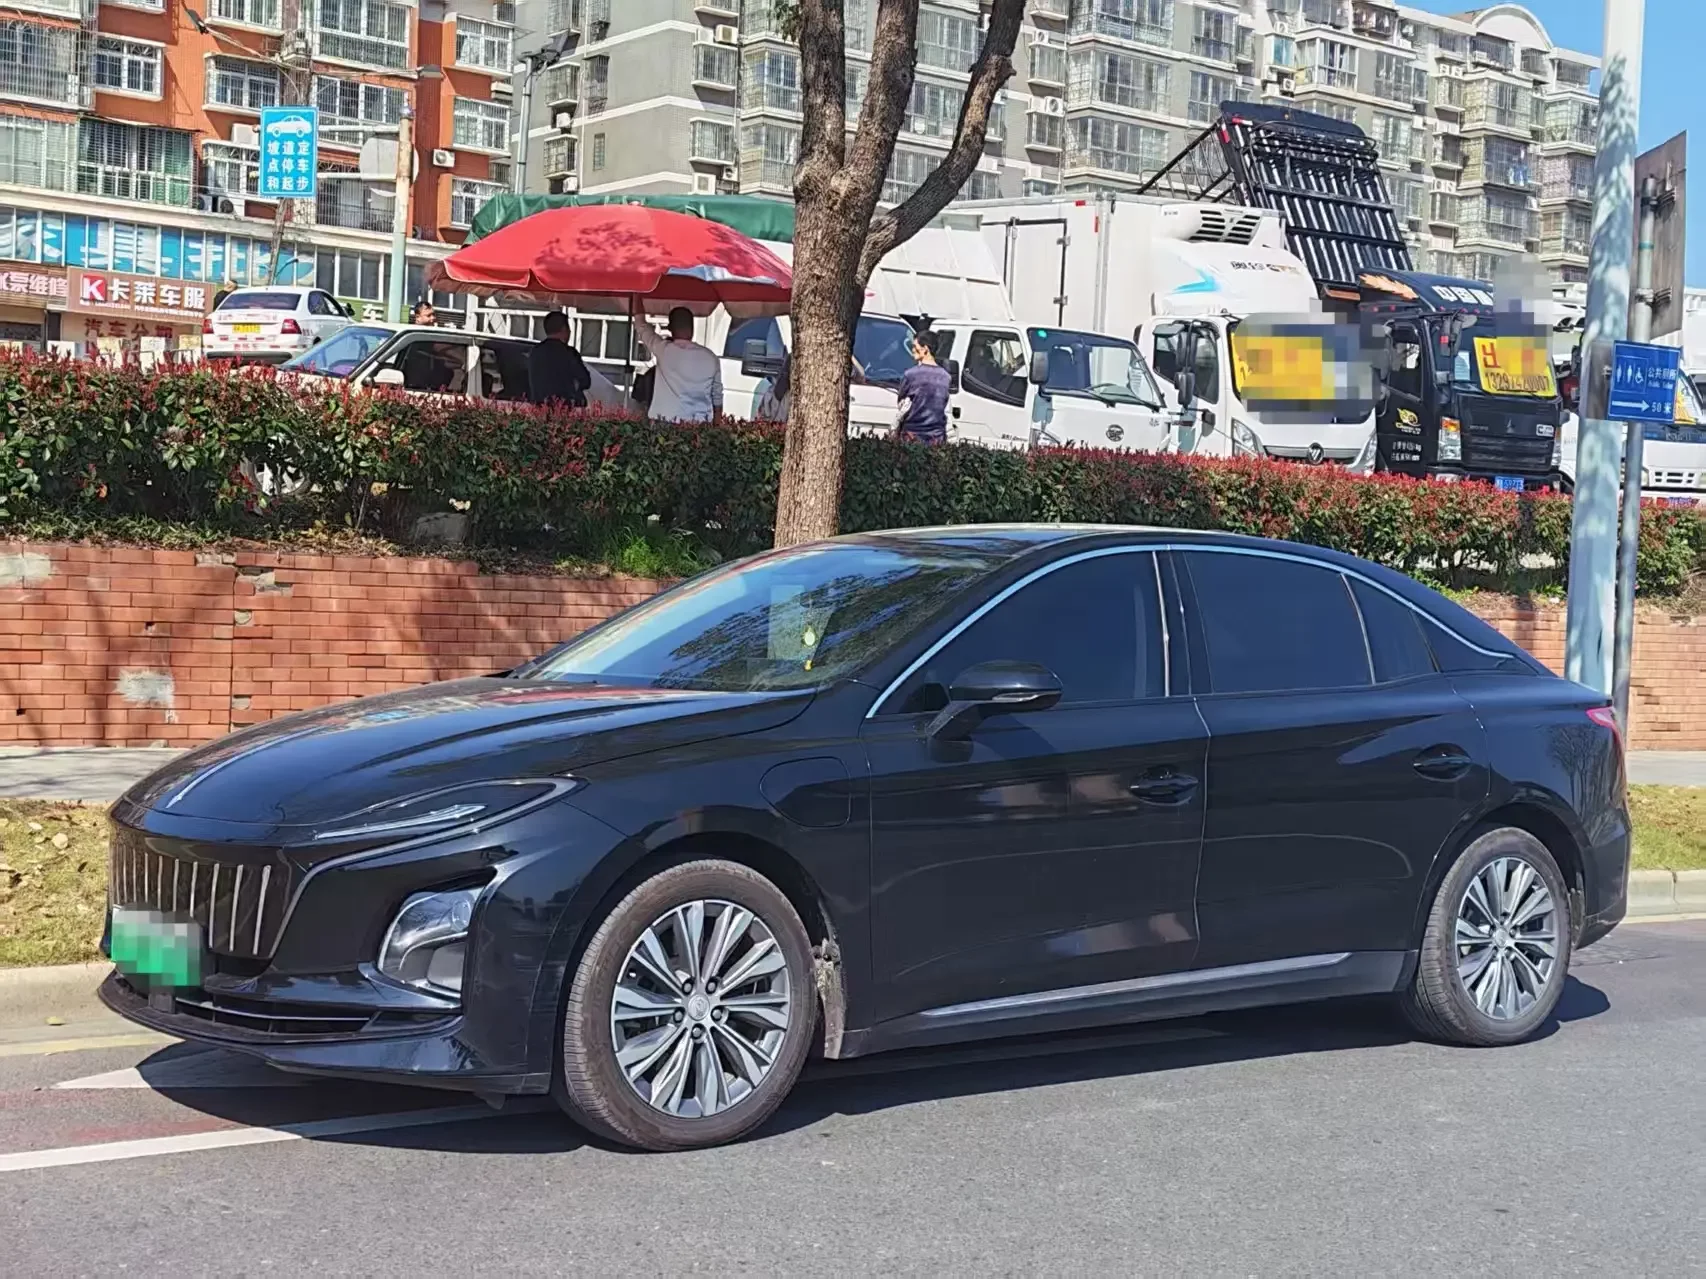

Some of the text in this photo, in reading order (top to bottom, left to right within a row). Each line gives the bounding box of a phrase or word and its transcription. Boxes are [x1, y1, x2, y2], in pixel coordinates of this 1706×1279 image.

[267, 157, 310, 174] 点停车
[267, 175, 309, 191] 和起步
[82, 277, 105, 300] K
[108, 278, 206, 309] 卡莱车服
[1651, 401, 1672, 414] 50 米
